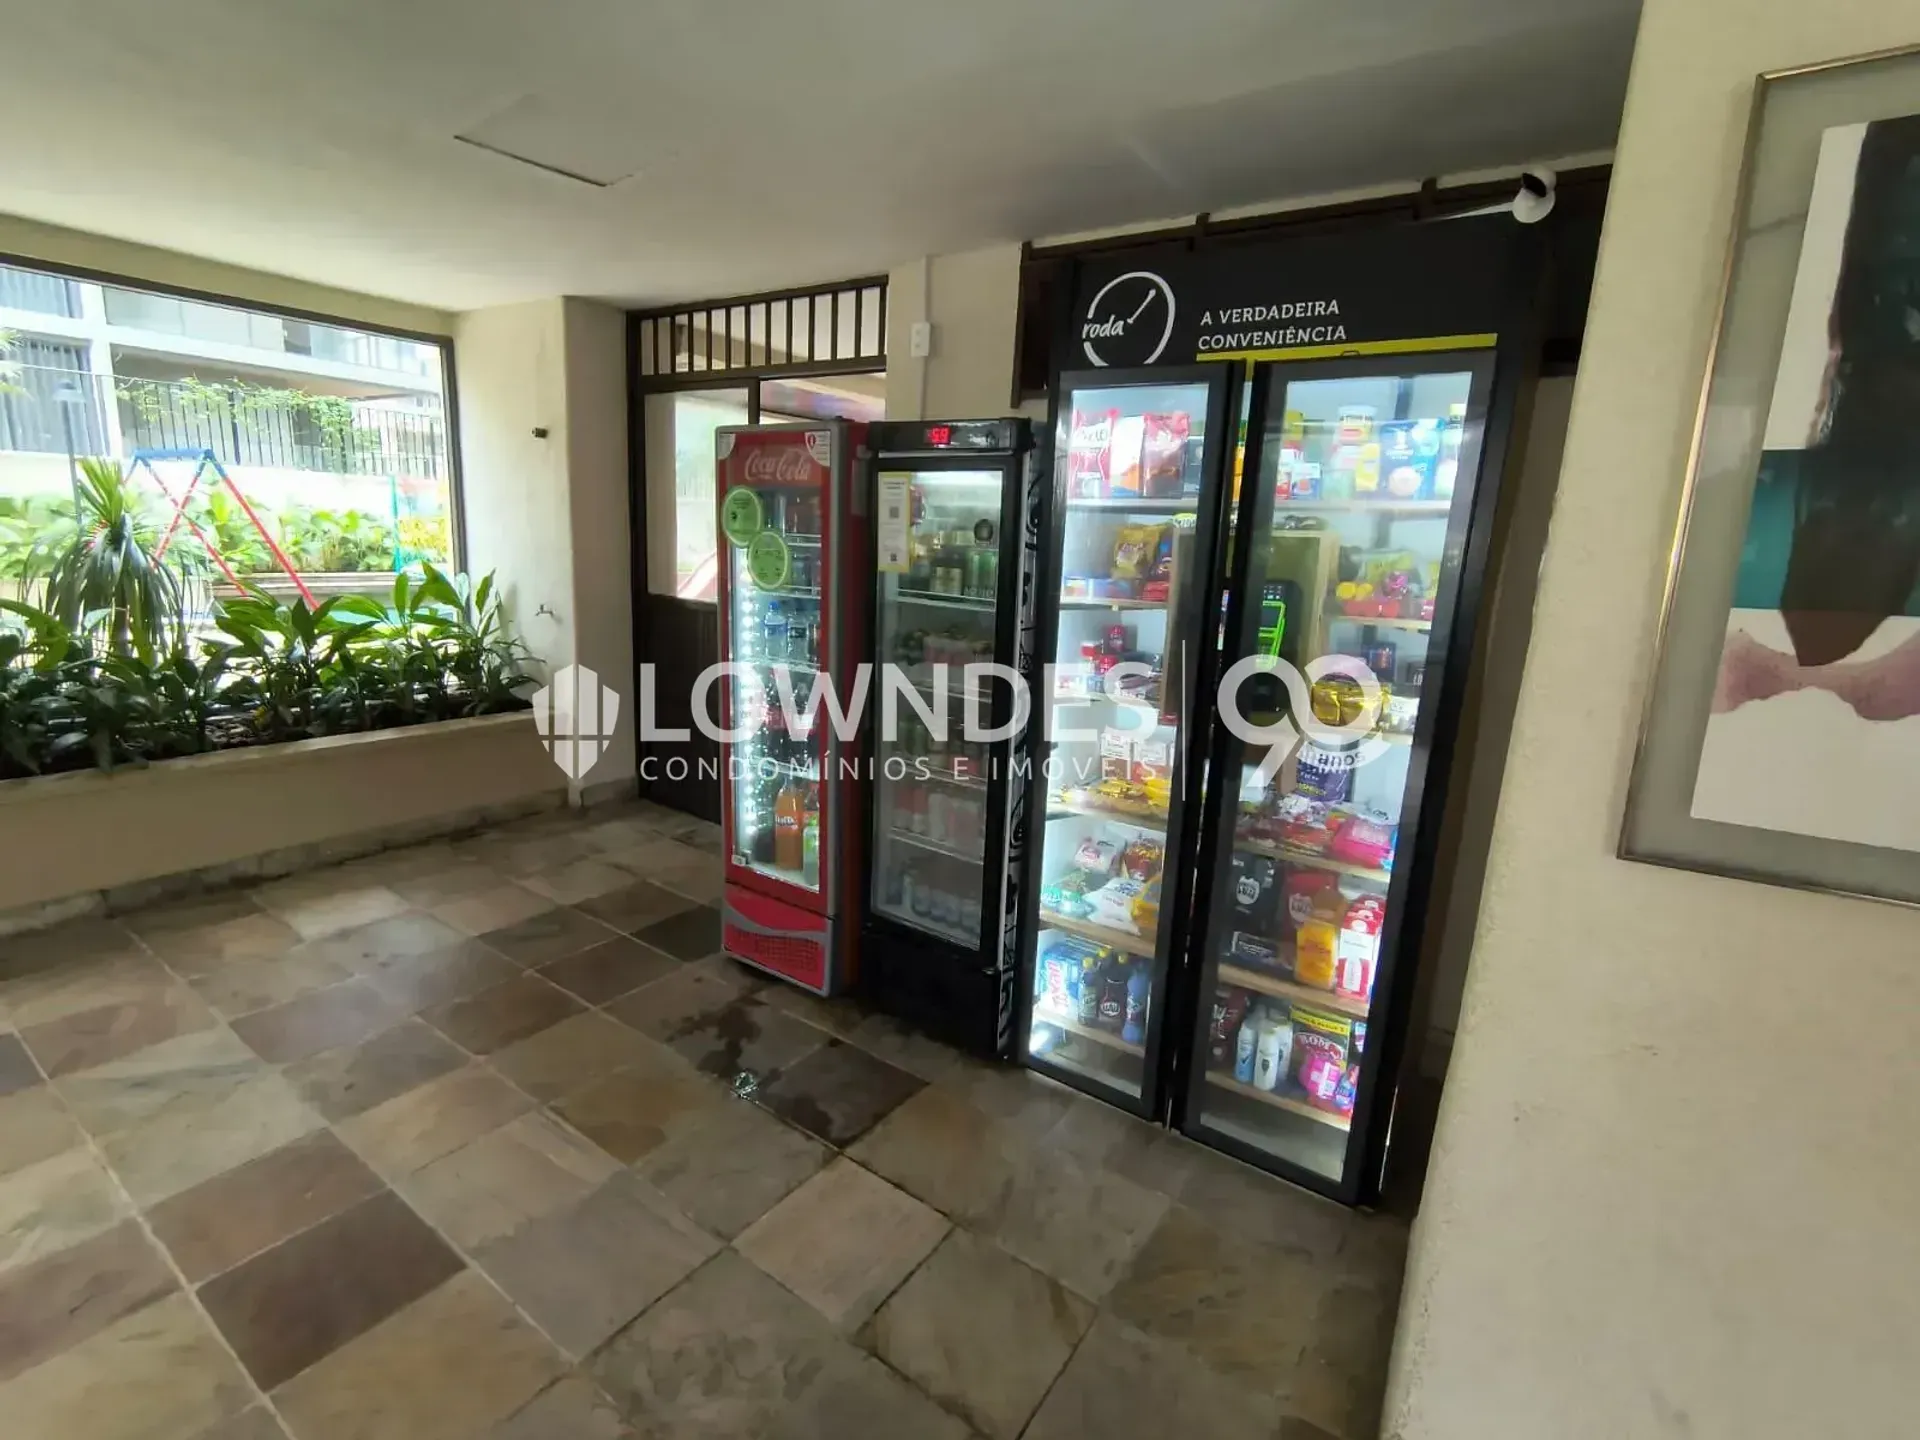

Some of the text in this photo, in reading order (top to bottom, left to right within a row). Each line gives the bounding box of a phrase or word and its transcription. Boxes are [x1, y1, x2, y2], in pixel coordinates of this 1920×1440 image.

[1200, 299, 1340, 326] A VERDADEIRA
[1082, 314, 1125, 340] roda
[1198, 325, 1347, 350] CONVENIÊNCIA
